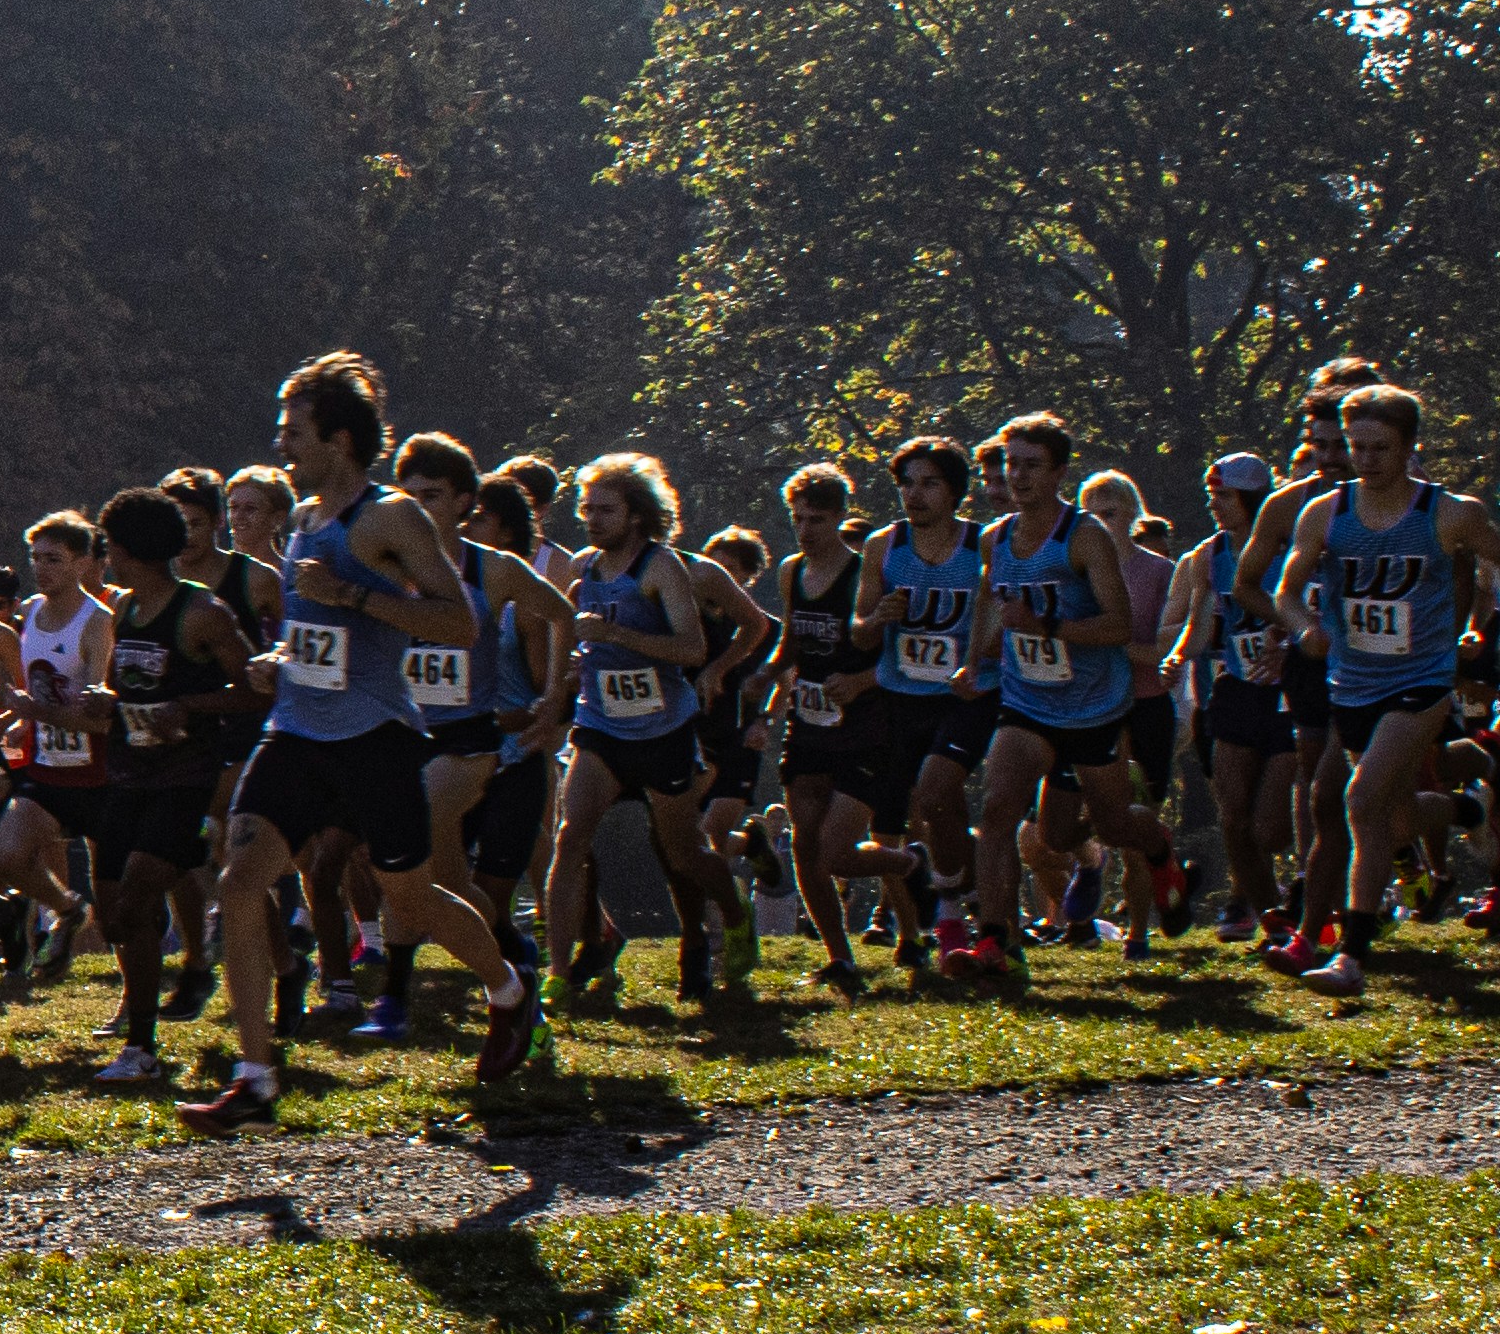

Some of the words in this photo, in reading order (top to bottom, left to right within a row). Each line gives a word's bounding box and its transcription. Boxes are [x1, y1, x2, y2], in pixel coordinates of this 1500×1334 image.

[1350, 604, 1397, 635] 461
[289, 626, 336, 666] 462
[905, 638, 948, 666] 472
[406, 653, 460, 685] 464
[606, 672, 651, 701] 465
